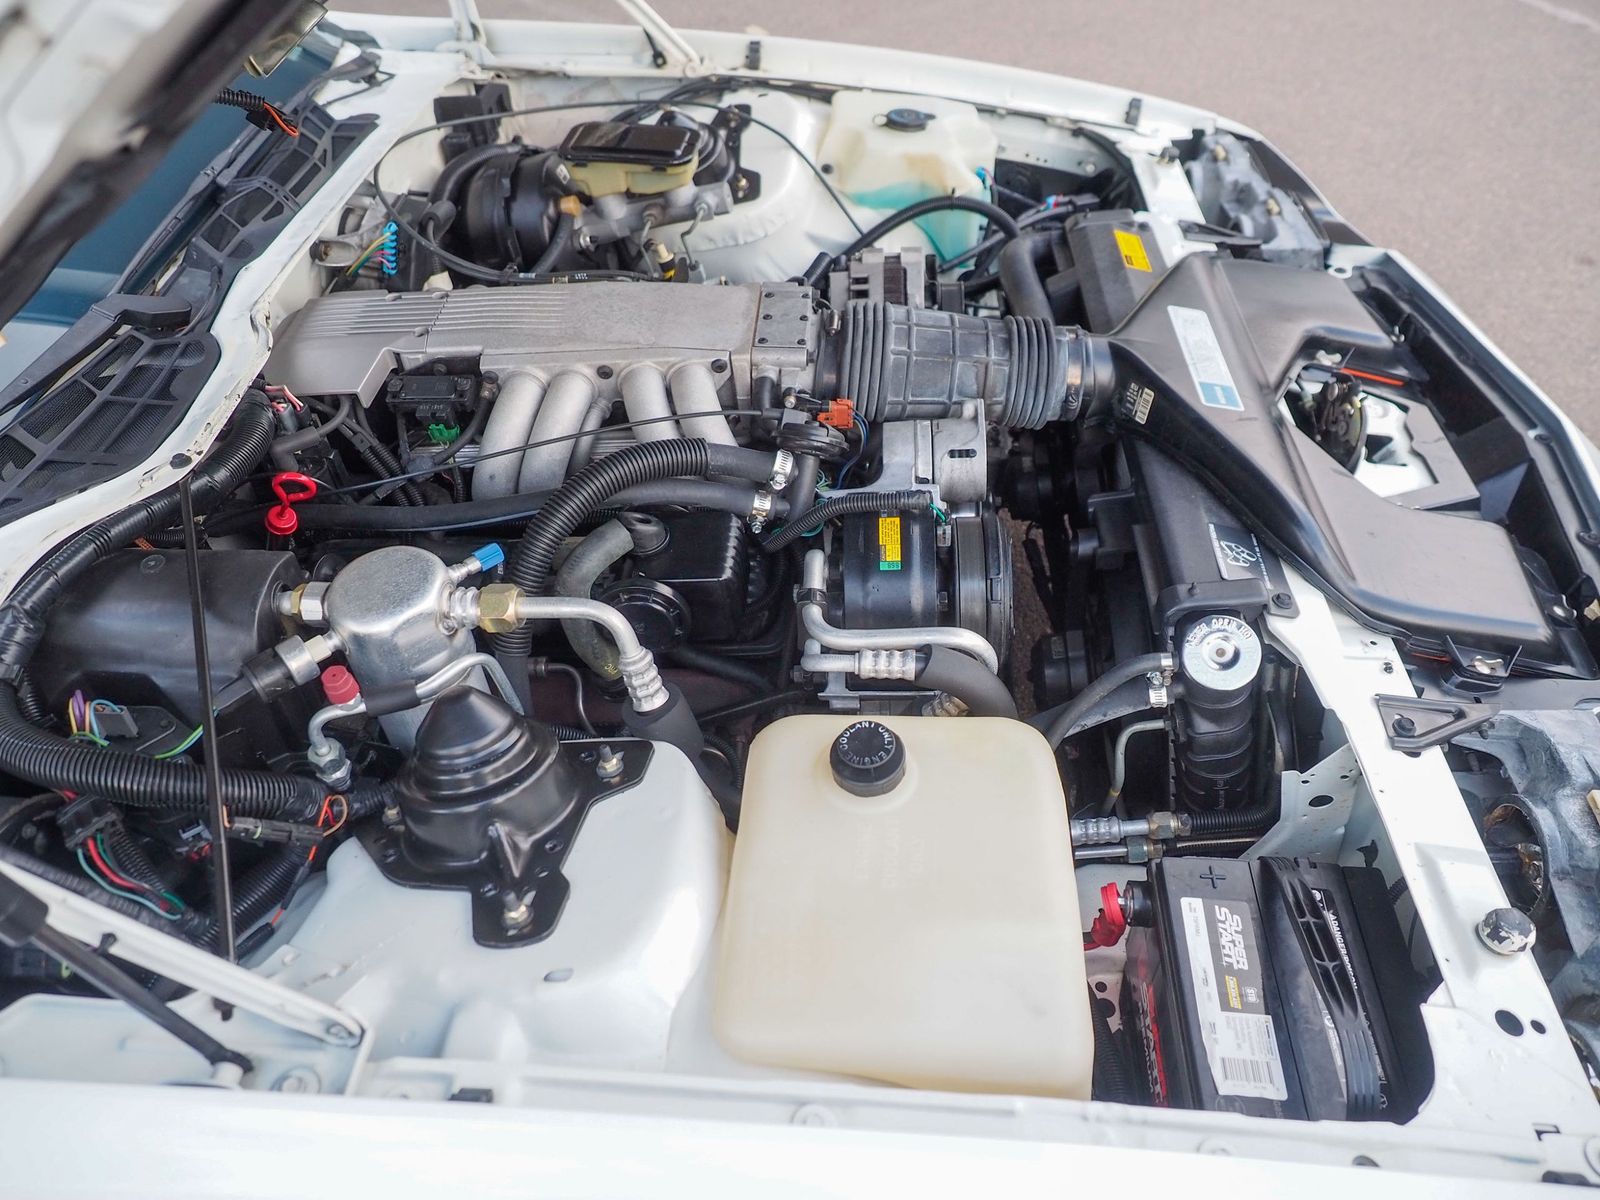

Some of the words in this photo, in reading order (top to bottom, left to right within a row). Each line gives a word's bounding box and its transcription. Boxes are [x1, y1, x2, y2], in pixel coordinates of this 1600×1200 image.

[1211, 617, 1239, 633] OPEN
[839, 721, 875, 751] COOLANT
[878, 725, 894, 750] ONLY
[845, 751, 888, 766] ENGINE
[1214, 904, 1239, 971] START
[1231, 914, 1249, 971] SUPER
